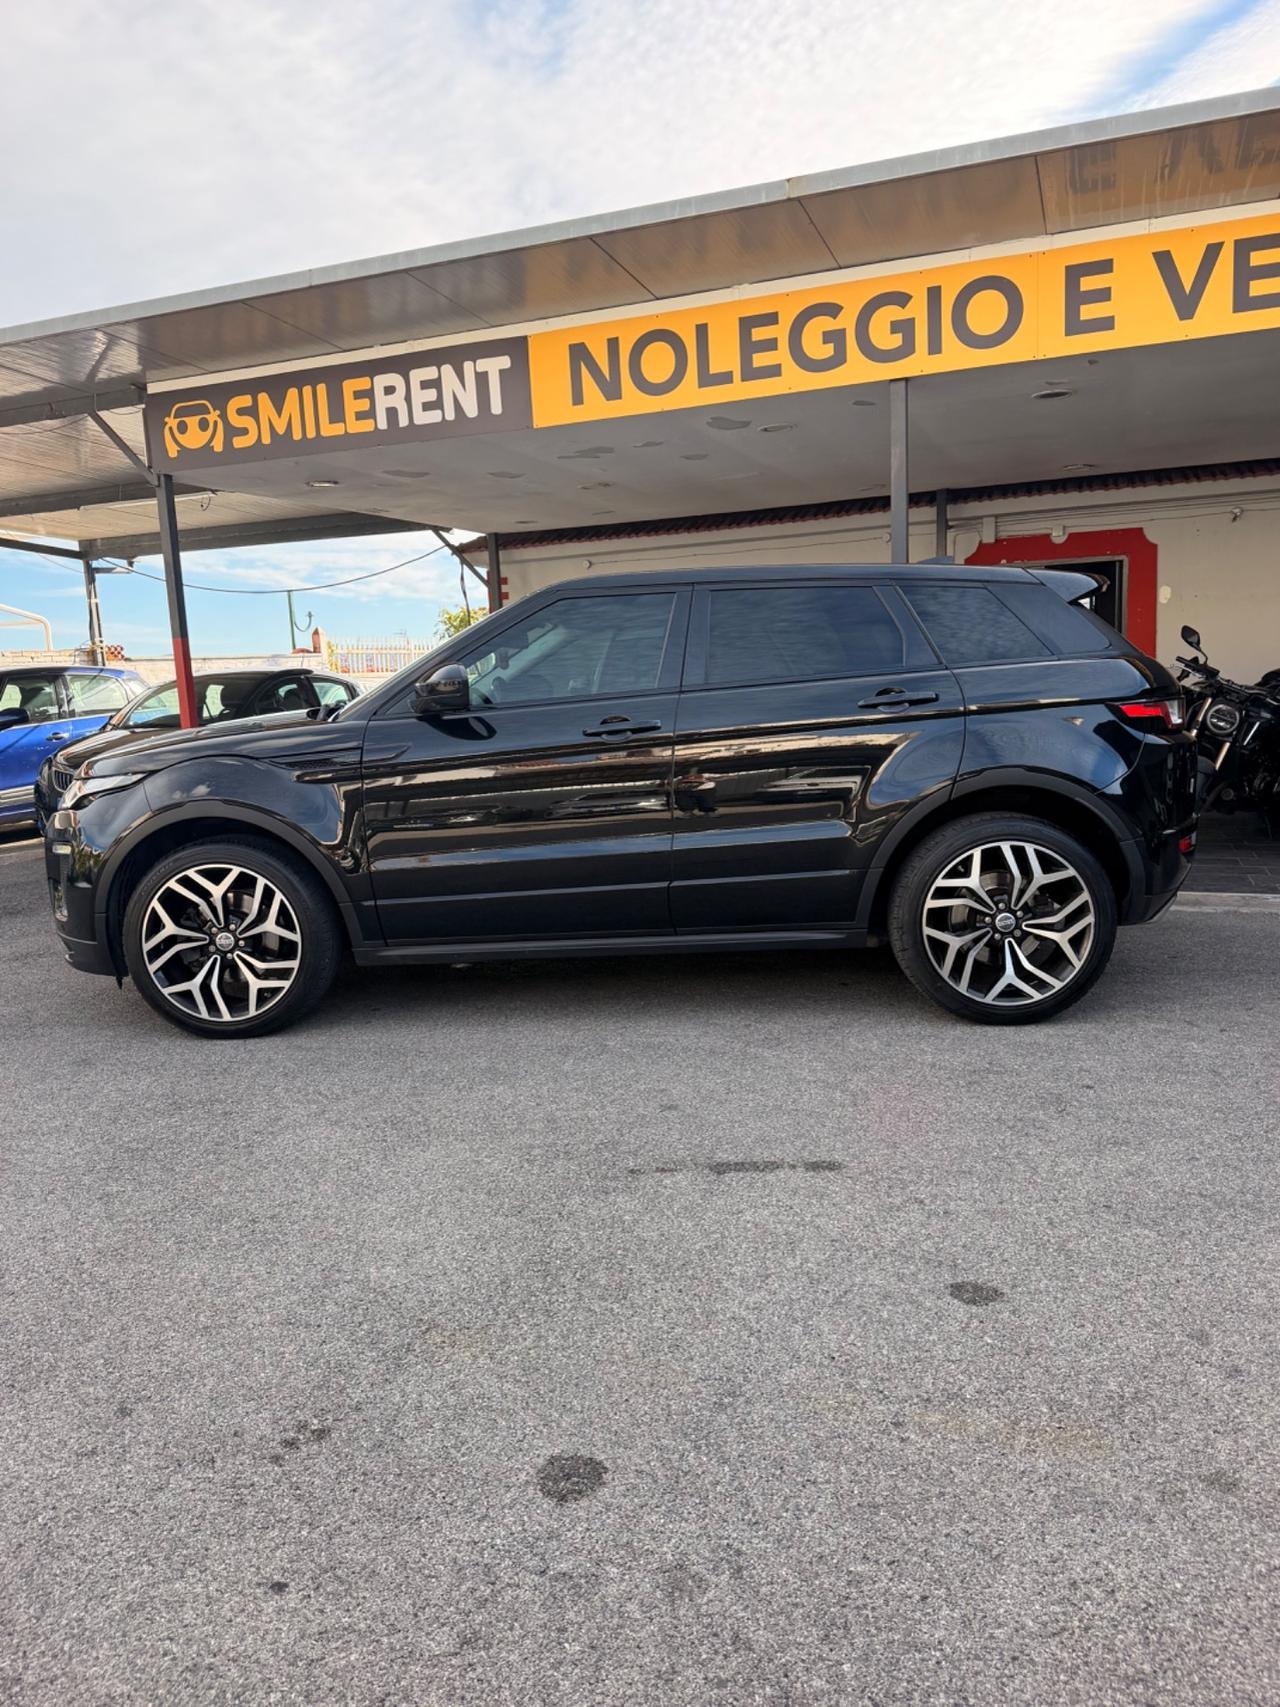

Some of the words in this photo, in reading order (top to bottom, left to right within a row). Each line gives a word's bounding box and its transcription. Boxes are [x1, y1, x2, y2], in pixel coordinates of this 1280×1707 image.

[569, 274, 1024, 406] NOLEGGIO
[1064, 257, 1116, 338] E
[226, 354, 512, 450] SMILERENT
